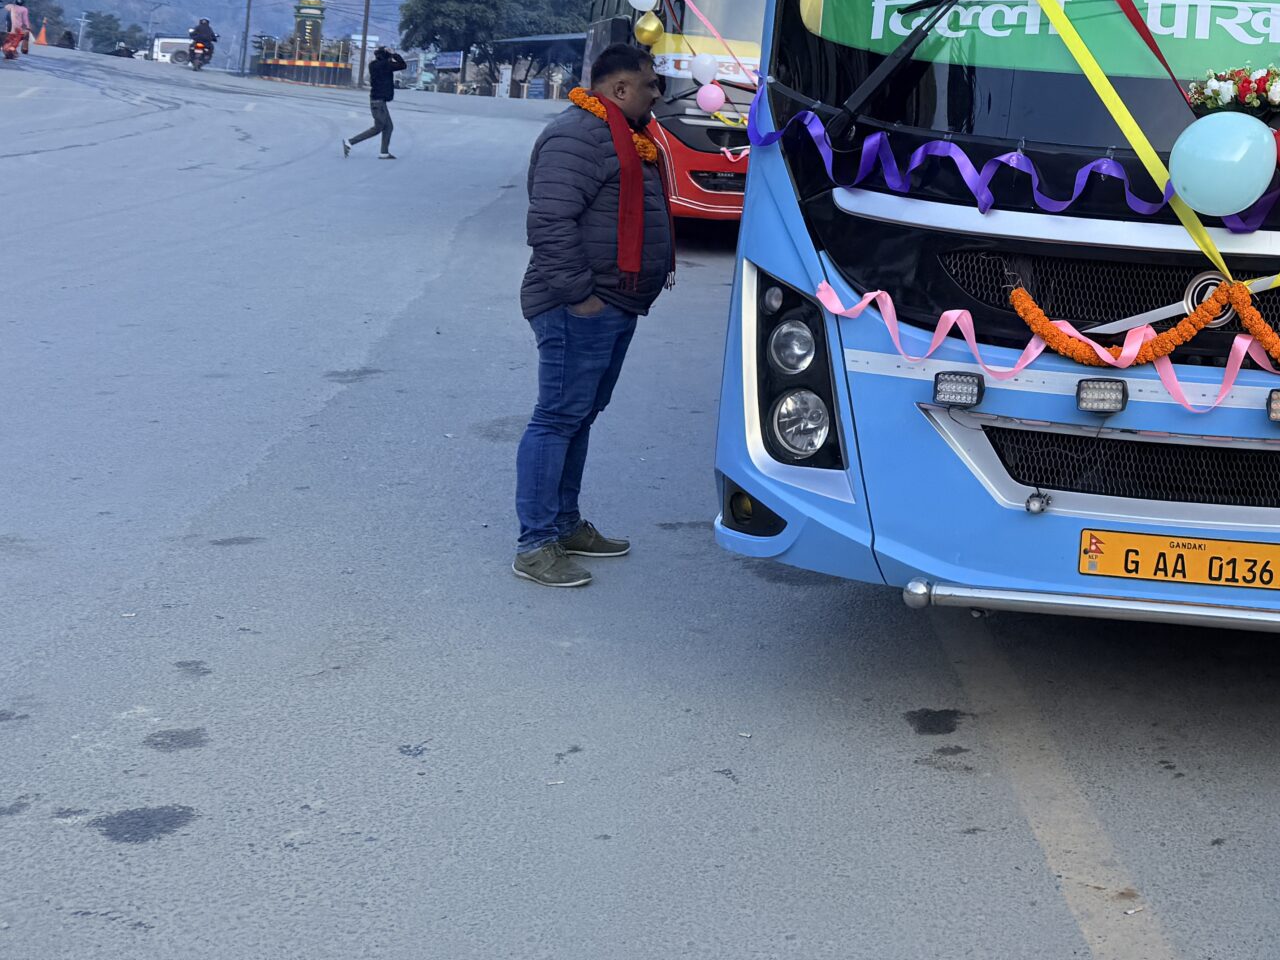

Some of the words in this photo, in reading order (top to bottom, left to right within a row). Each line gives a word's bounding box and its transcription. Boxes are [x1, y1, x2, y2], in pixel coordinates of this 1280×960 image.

[1169, 541, 1207, 551] GANDAKI
[1124, 548, 1140, 575] G
[1153, 552, 1187, 579] AA
[1208, 556, 1274, 586] 0136
